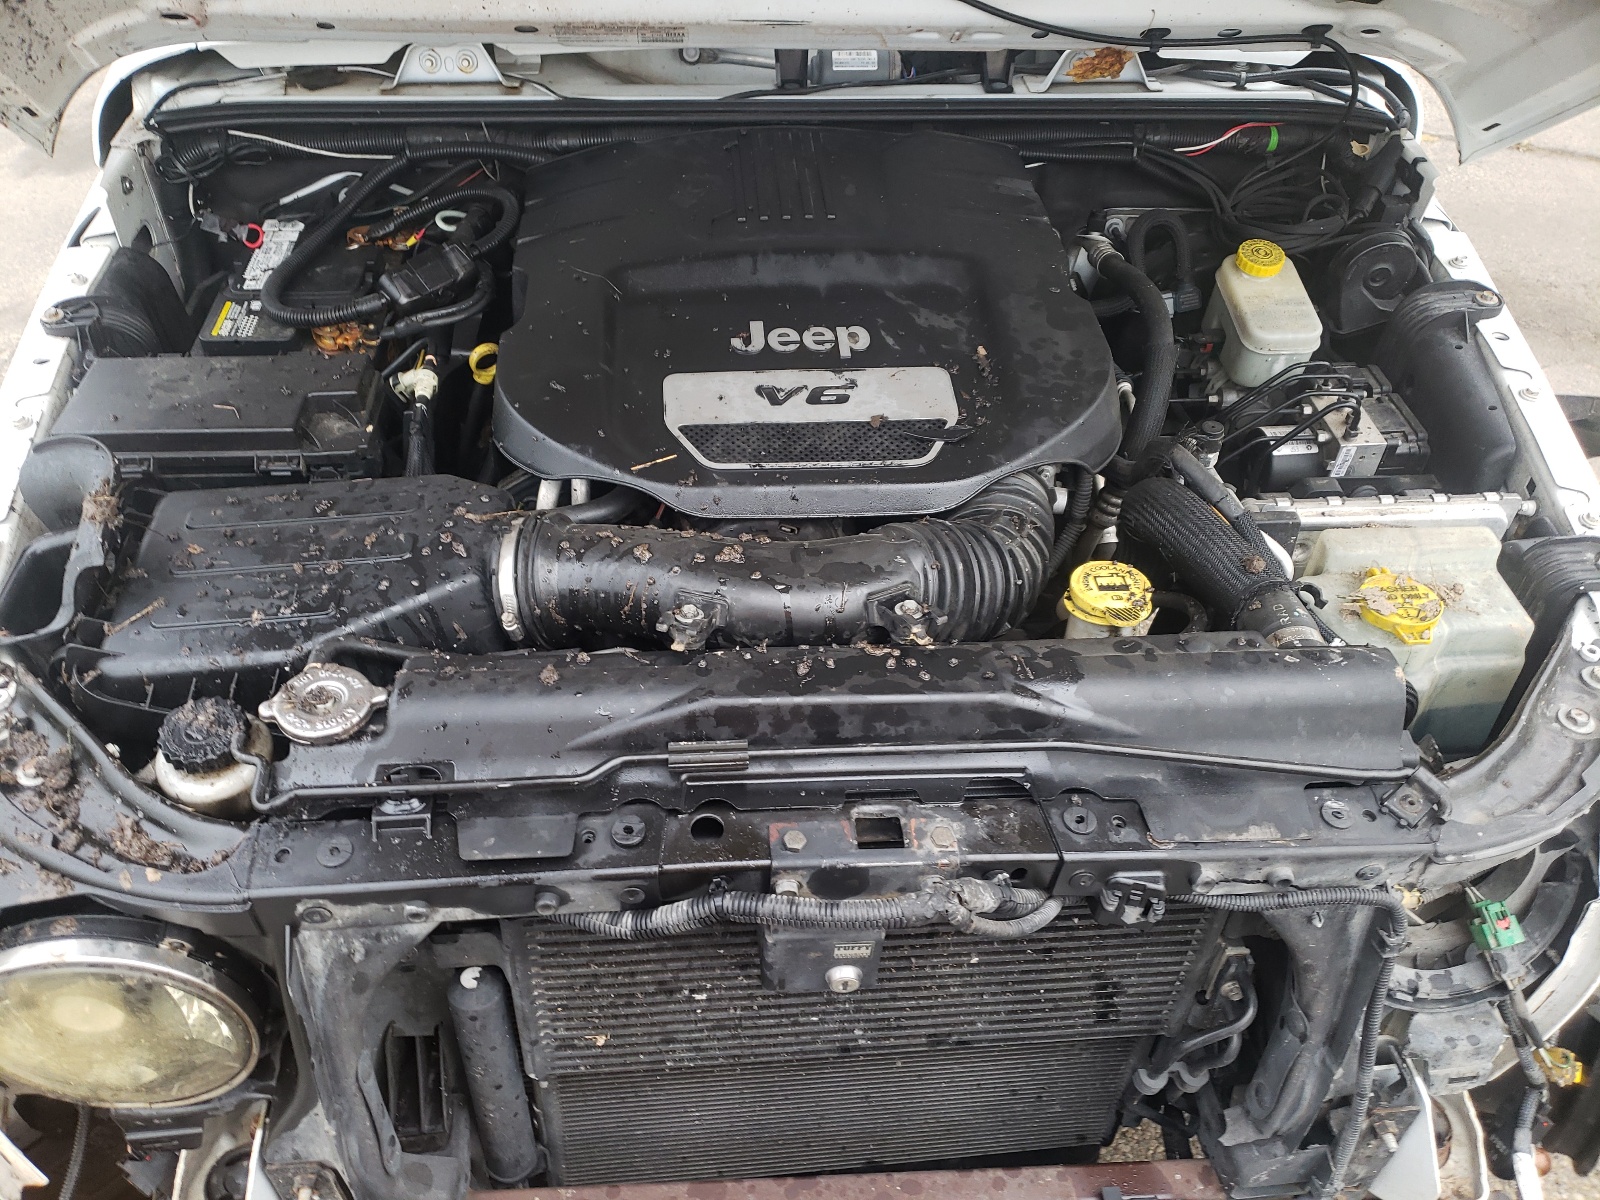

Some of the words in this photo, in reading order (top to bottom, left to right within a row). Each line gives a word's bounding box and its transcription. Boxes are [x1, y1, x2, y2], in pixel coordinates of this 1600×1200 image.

[730, 320, 871, 360] Jeep
[755, 384, 858, 406] V6
[1273, 603, 1292, 626] RAD
